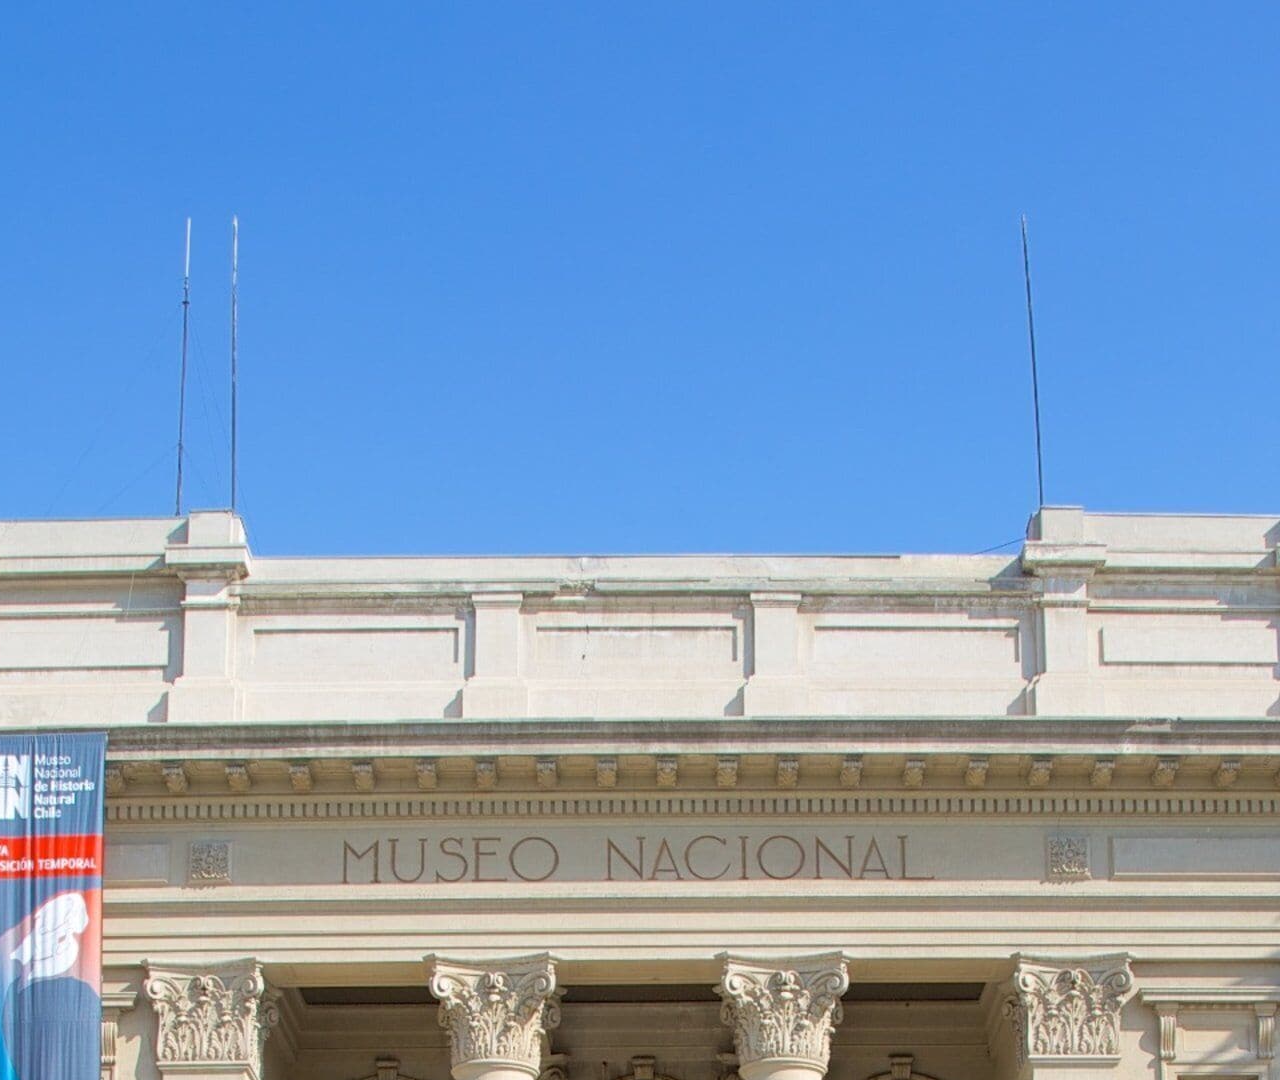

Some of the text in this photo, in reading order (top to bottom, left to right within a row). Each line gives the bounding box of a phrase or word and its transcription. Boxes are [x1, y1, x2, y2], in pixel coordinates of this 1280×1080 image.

[35, 754, 71, 766] Museo
[34, 766, 81, 779] Nacional
[34, 779, 95, 792] de Historia
[34, 793, 75, 805] Natural
[34, 807, 62, 819] Chile
[37, 857, 97, 869] TEMPORAL
[341, 835, 936, 884] MUSEO NACIONAL
